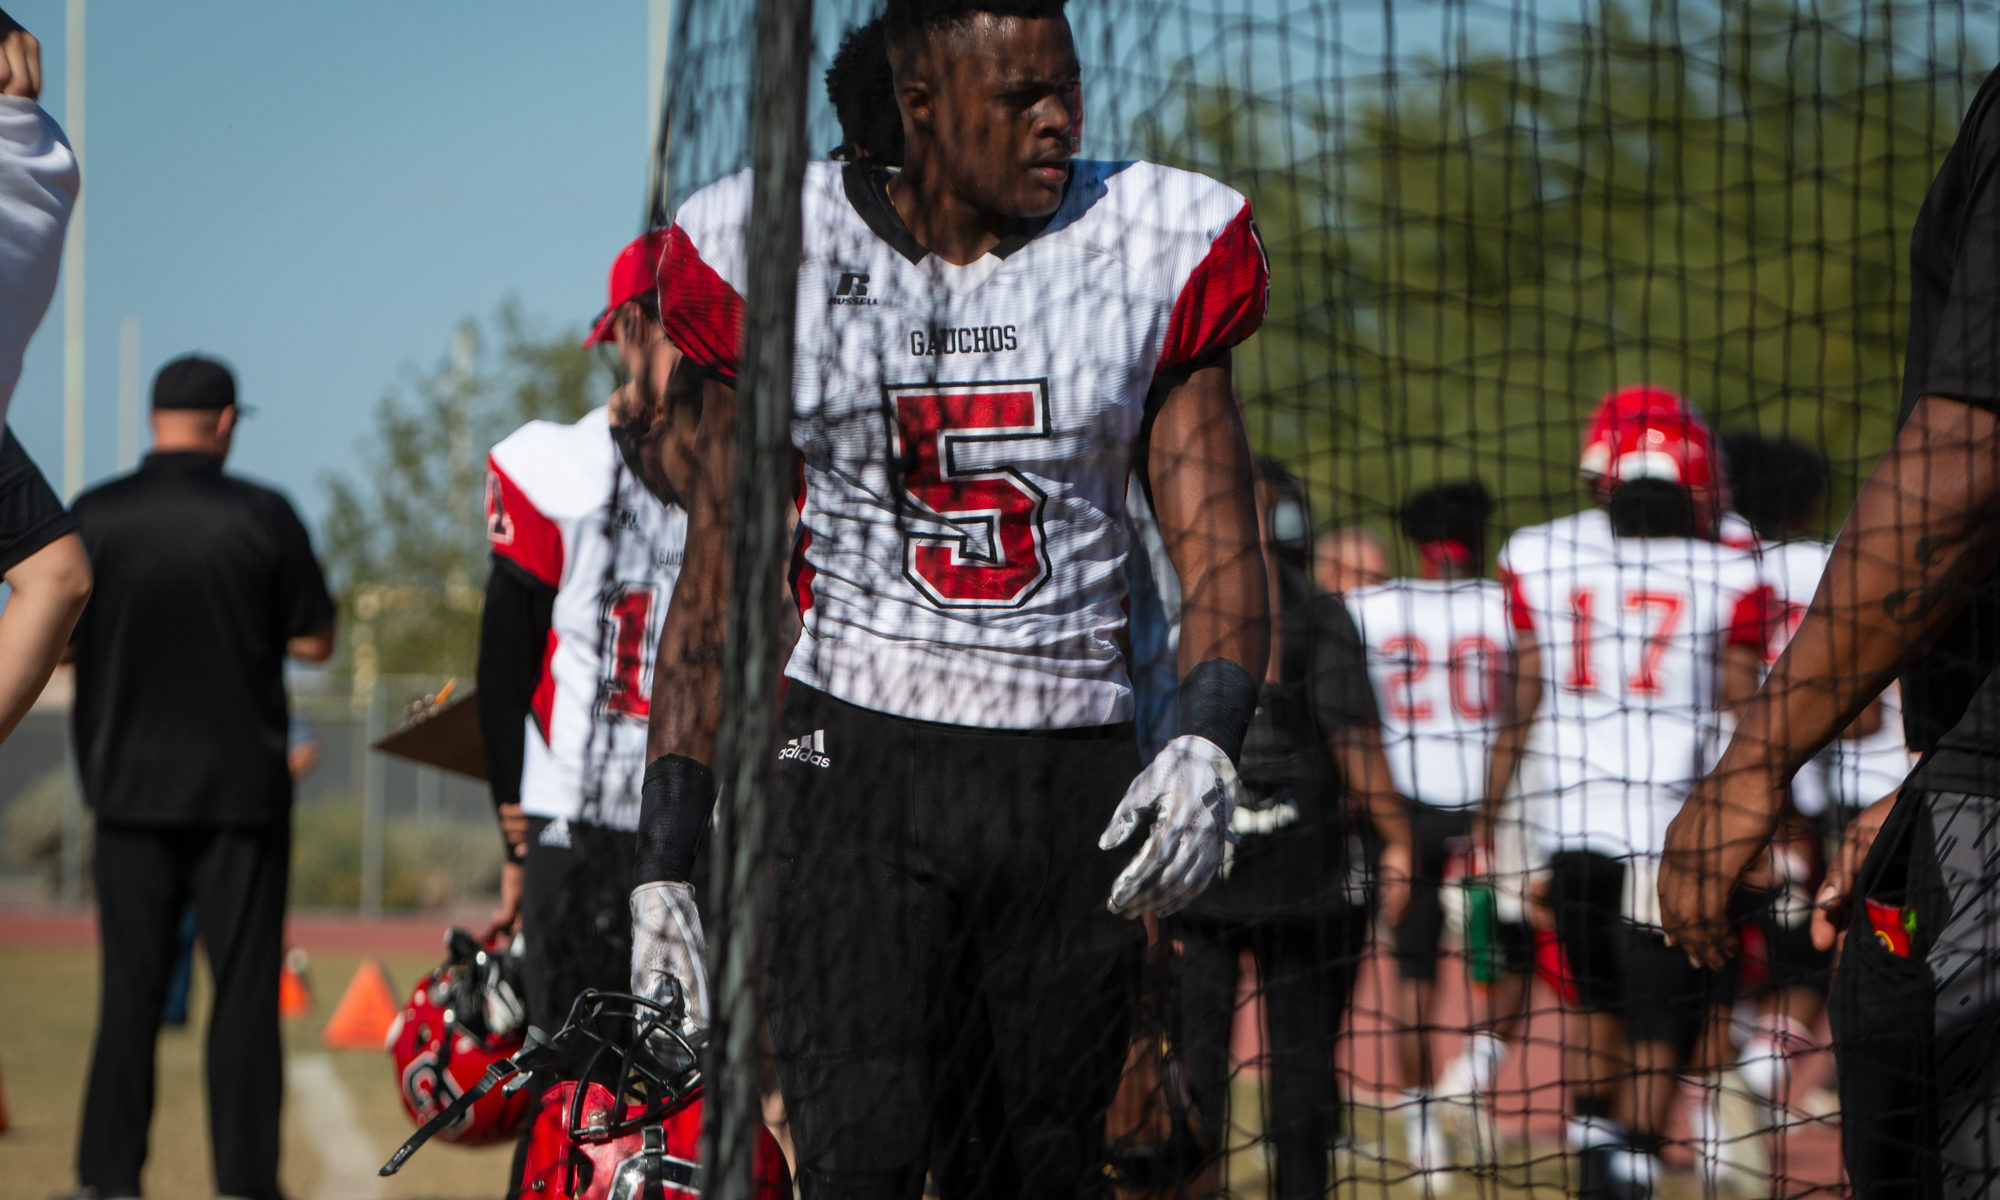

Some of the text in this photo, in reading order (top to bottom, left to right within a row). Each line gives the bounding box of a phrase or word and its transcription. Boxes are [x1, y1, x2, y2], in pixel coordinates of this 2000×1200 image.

[911, 324, 1017, 356] GAUCHOS
[883, 377, 1051, 609] 5
[1381, 632, 1501, 720] 20
[1566, 587, 1684, 696] 17
[778, 745, 830, 768] adidas
